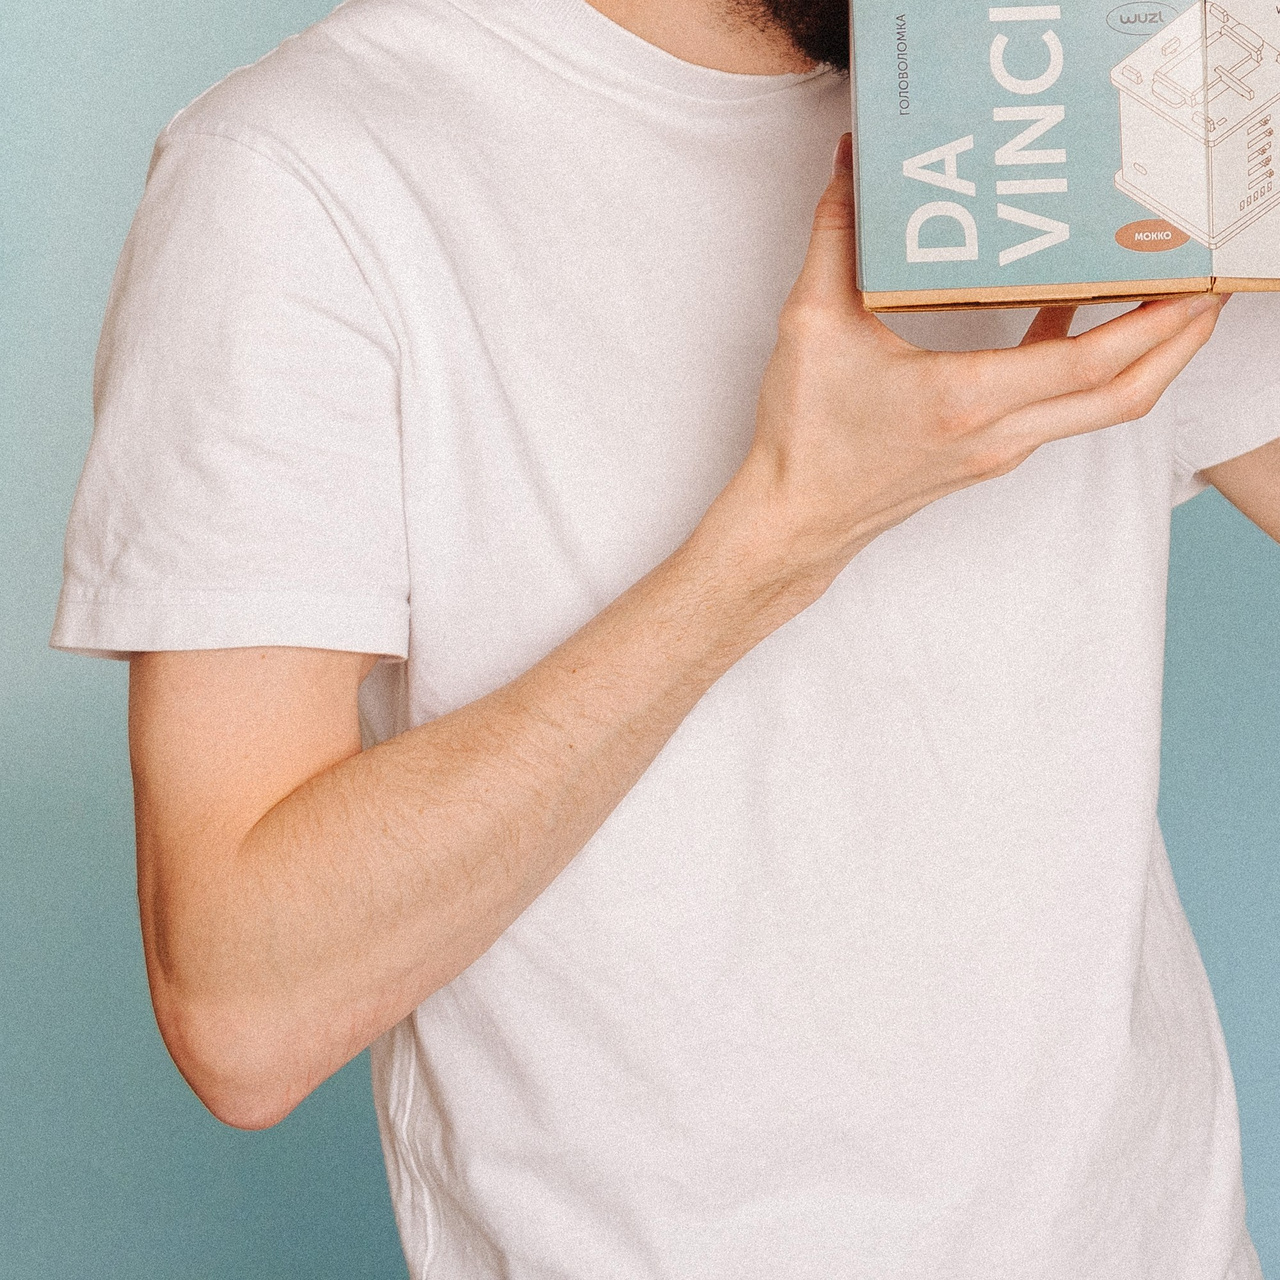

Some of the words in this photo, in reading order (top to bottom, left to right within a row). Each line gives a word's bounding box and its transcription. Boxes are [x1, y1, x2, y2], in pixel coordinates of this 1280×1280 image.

[896, 14, 910, 116] ГОЛОВОЛОМКА
[1120, 11, 1164, 24] wuzl
[988, 5, 1070, 266] VINCI
[902, 134, 979, 263] DA
